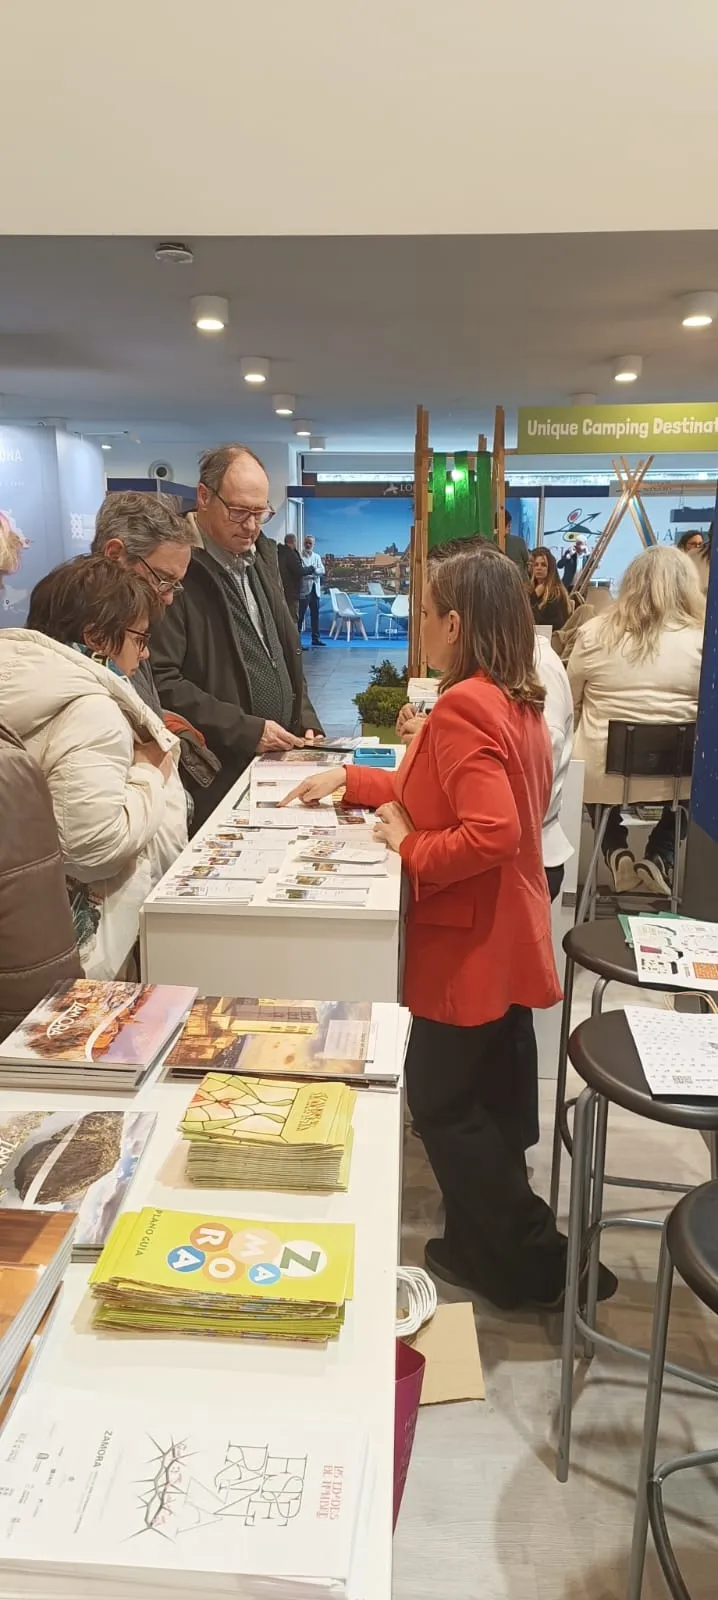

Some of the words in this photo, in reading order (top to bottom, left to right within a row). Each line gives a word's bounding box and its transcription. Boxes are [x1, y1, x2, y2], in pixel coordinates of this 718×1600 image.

[527, 419, 578, 440] Unique
[582, 418, 649, 439] Camping
[146, 1208, 163, 1236] PLANO
[93, 1430, 113, 1468] ZAMORA
